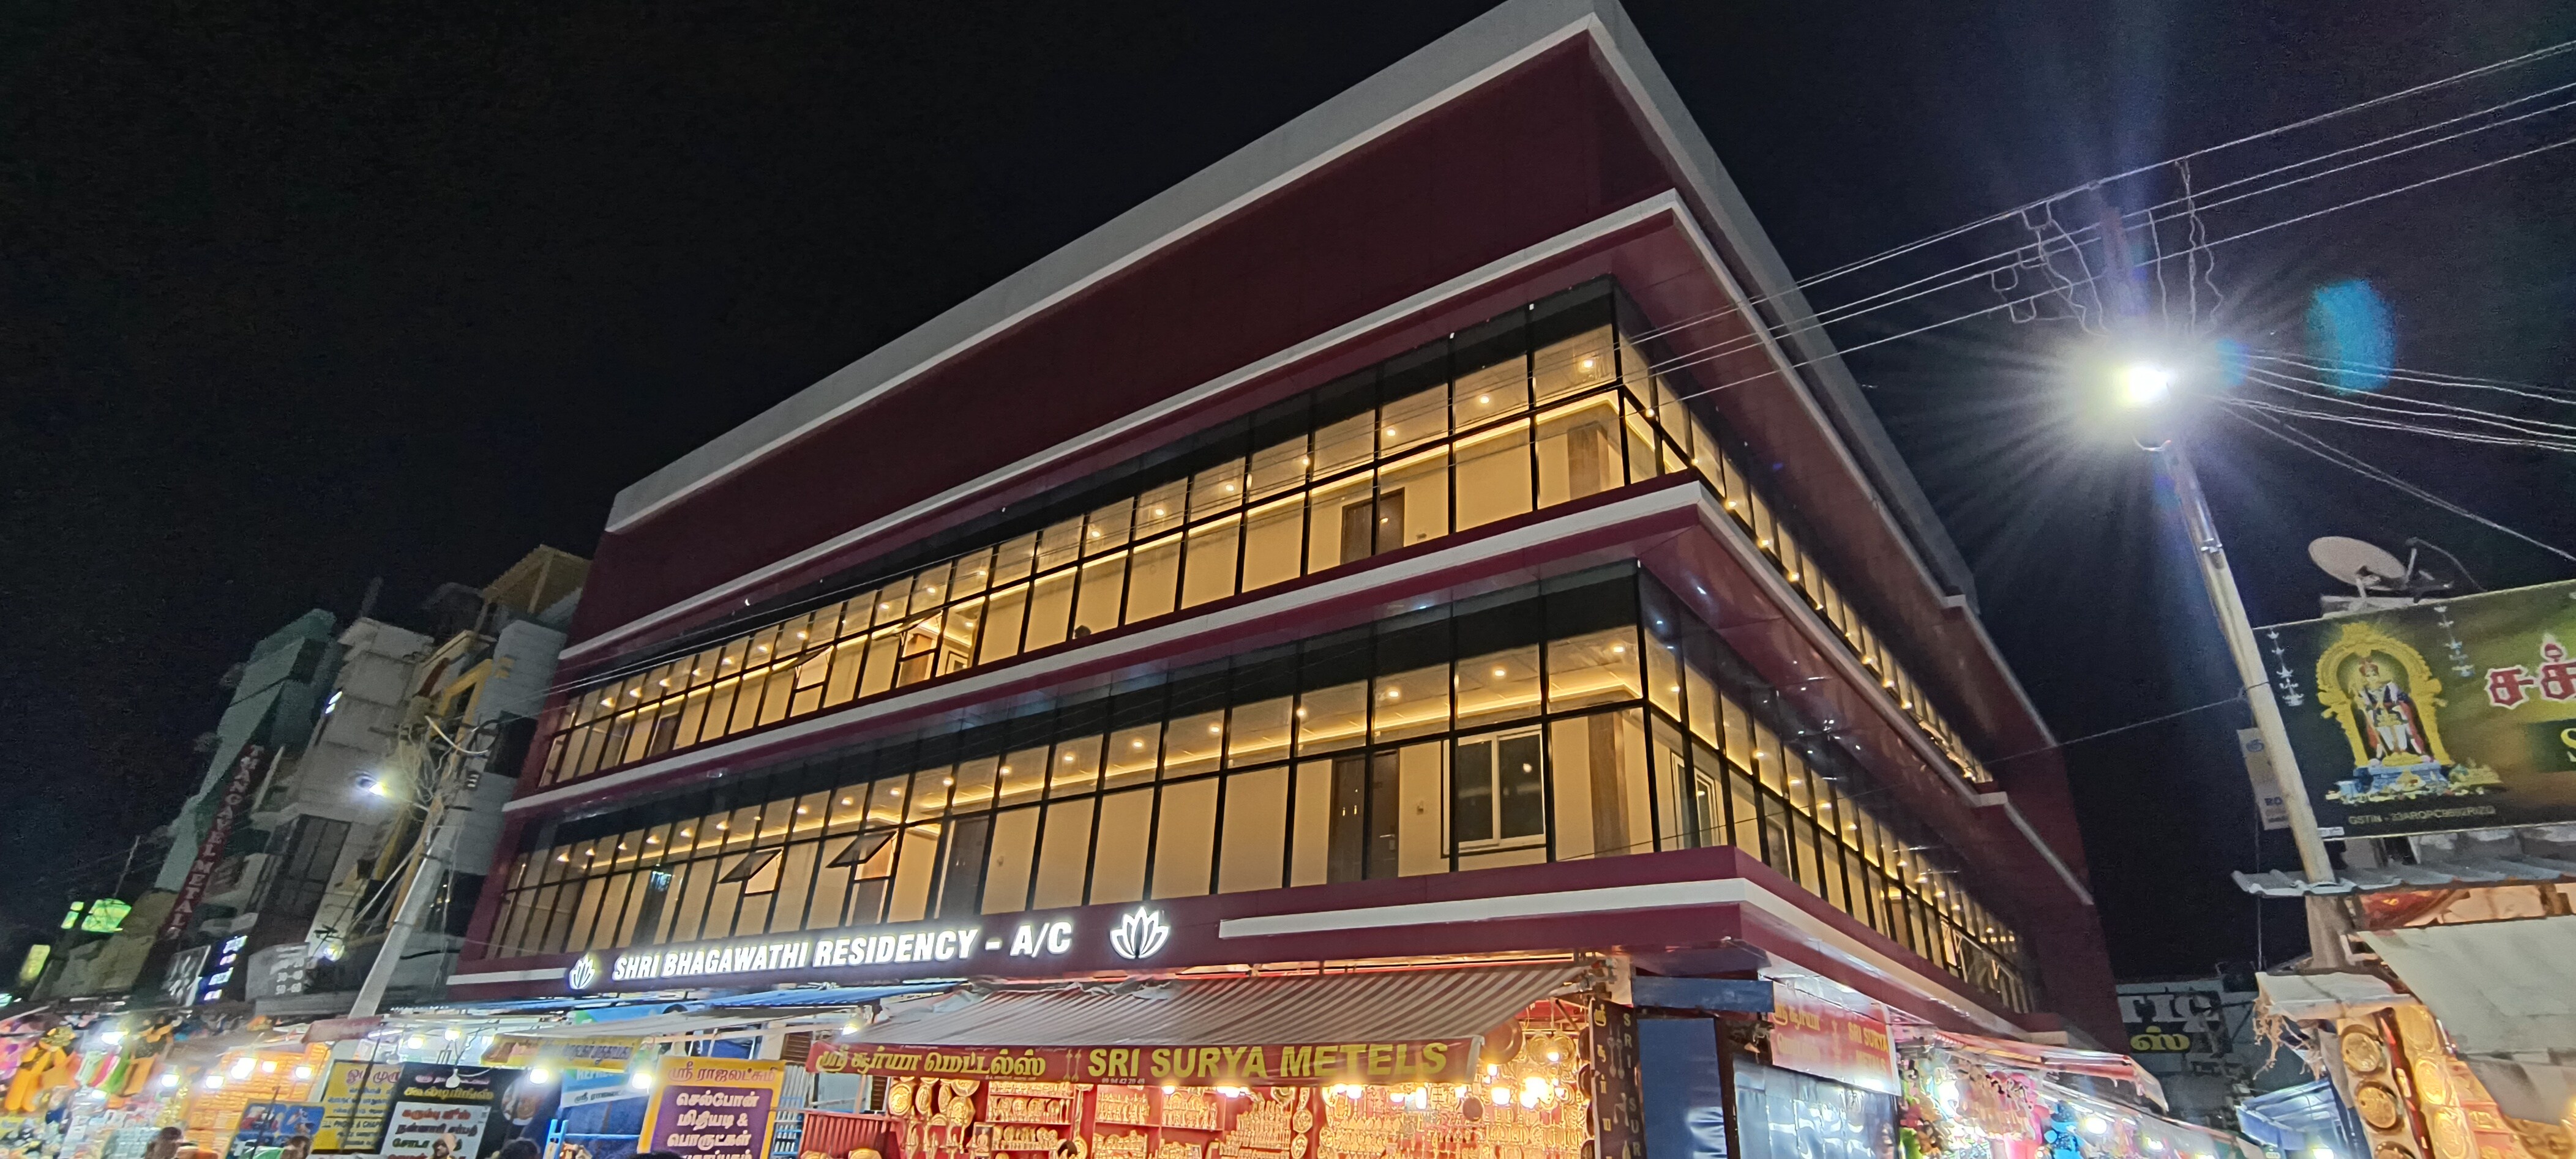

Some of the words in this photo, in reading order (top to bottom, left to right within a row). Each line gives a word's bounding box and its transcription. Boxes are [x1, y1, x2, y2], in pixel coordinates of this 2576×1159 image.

[2348, 814, 2383, 824] GSTIN
[613, 955, 661, 980] SHRI
[661, 942, 809, 978] BHAGAWATHI
[812, 929, 979, 967] RESIDENCY
[1009, 922, 1073, 958] A/C
[1848, 1021, 1862, 1044] SRI
[1863, 1027, 1889, 1053] SURYA
[924, 1048, 1046, 1076] மெட்டல்ஸ்
[1087, 1048, 1140, 1077] SRI
[1150, 1046, 1268, 1078] SURYA
[1280, 1042, 1448, 1078] METELS
[676, 1090, 760, 1108] செல்போன்
[736, 1112, 748, 1127] &
[667, 1130, 752, 1150] பொருட்கள்
